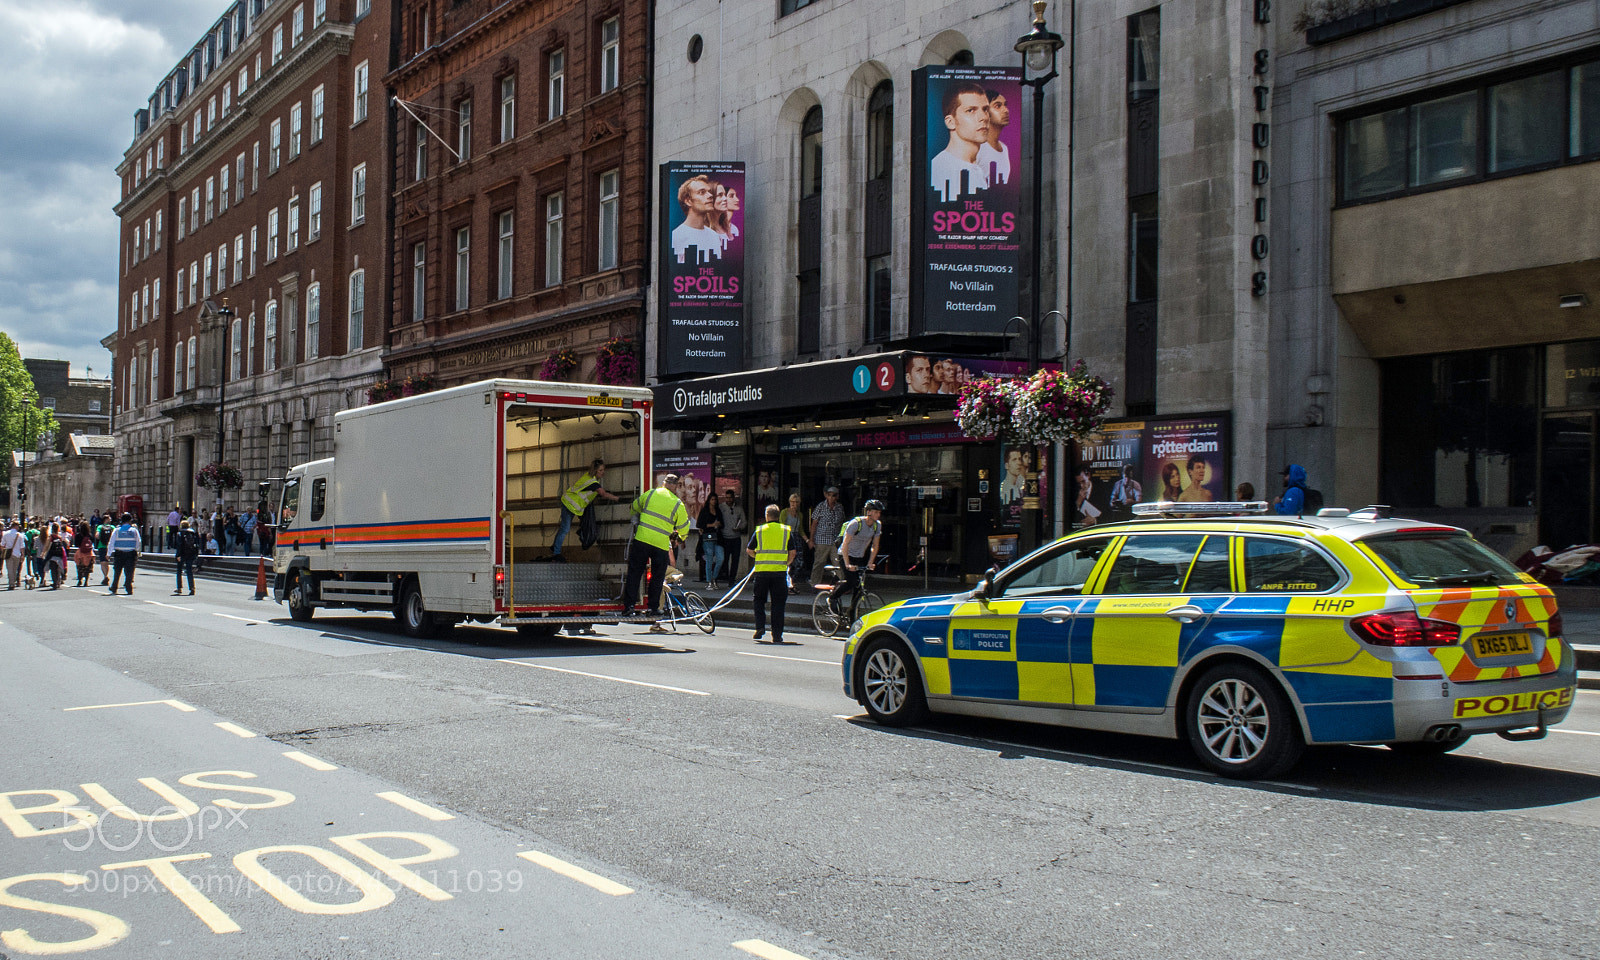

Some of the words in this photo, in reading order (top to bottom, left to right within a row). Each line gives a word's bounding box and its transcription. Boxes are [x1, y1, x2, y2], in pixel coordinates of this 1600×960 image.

[1251, 48, 1270, 298] STUDIOS
[964, 200, 984, 210] THE
[933, 210, 1015, 233] SPOILS
[699, 267, 714, 276] THE
[929, 263, 973, 271] TRAFALGAR
[974, 264, 1007, 273] STUDIOS
[673, 275, 740, 293] SPOILS
[950, 281, 964, 291] No
[965, 281, 994, 291] Villain
[946, 301, 996, 311] Rotterdam
[708, 319, 734, 327] STUDIOS
[688, 333, 700, 341] No
[700, 333, 724, 342] Villain
[685, 348, 727, 358] Rotterdam
[881, 366, 889, 386] 2
[687, 390, 727, 408] Trafalgar
[728, 385, 762, 402] Studios
[857, 434, 872, 447] THE
[873, 430, 905, 446] SPOILS
[1082, 446, 1094, 461] NO
[1096, 444, 1131, 460] VILLAIN
[1287, 582, 1318, 590] FITTED
[1312, 599, 1355, 612] HHP
[973, 632, 1009, 640] METROPOLITAN
[1477, 636, 1508, 654] BX65
[1508, 635, 1529, 652] DLJ
[1456, 688, 1571, 717] POLICE
[0, 770, 296, 838] BUS
[0, 831, 459, 955] STOP
